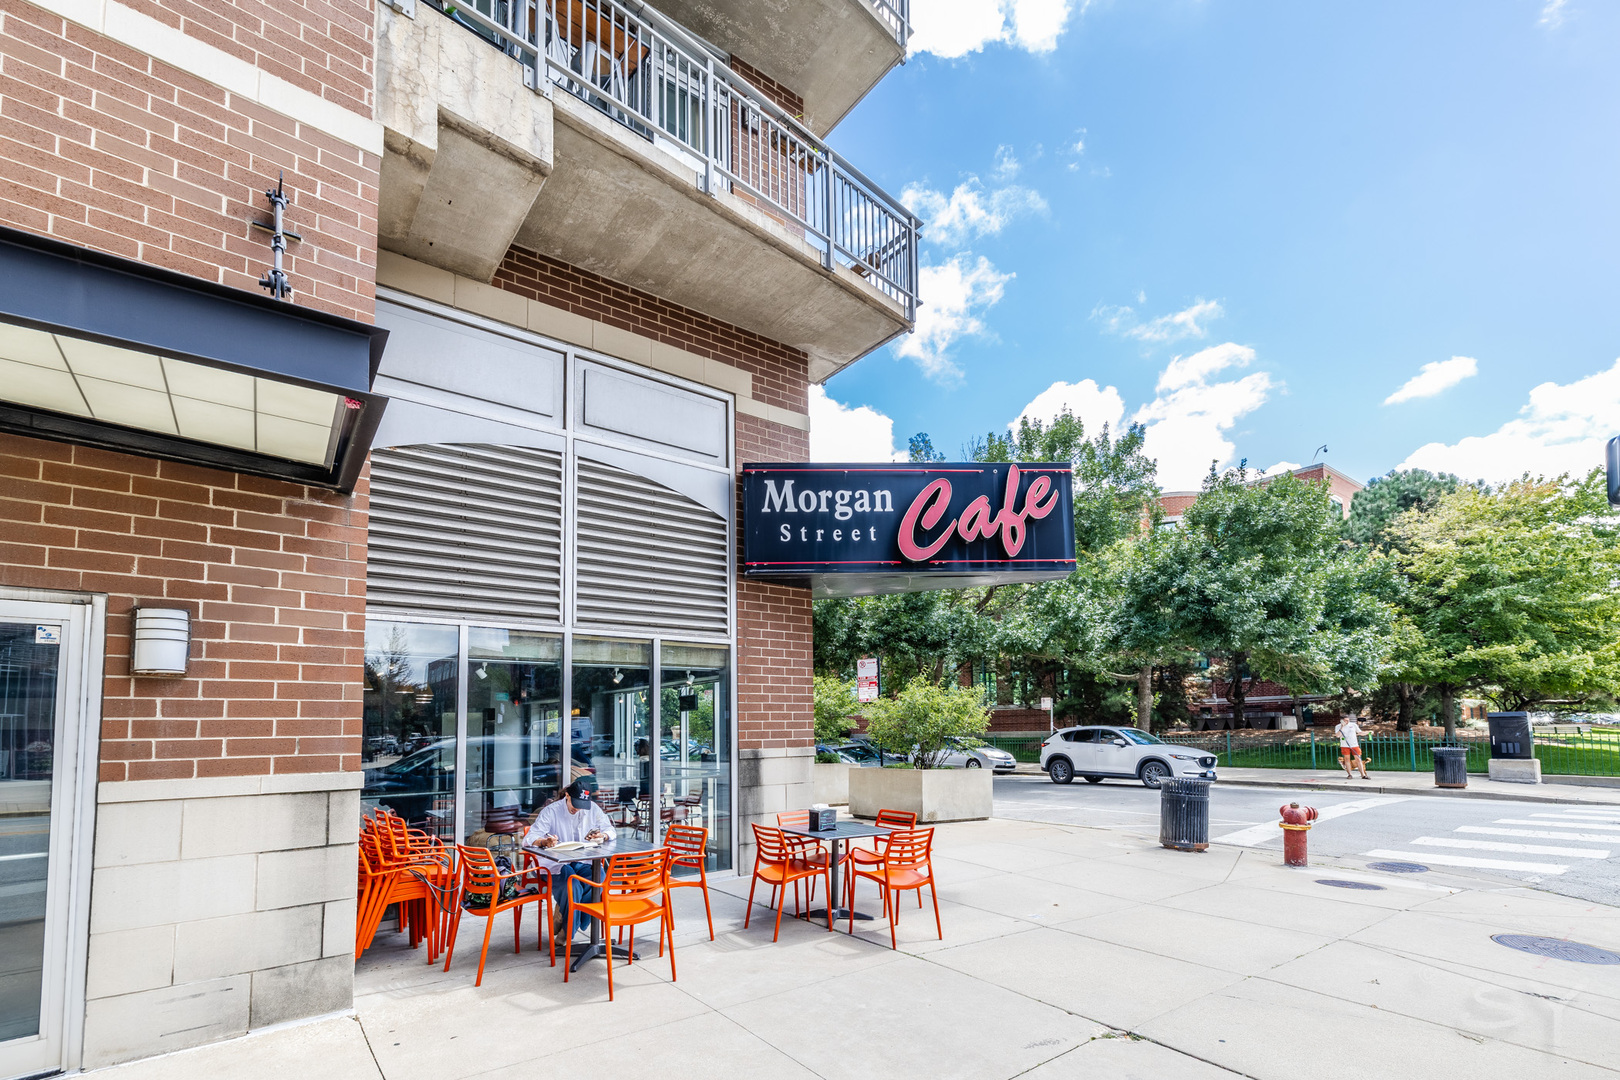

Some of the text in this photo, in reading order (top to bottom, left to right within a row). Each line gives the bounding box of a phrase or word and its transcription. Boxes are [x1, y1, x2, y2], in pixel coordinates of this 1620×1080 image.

[761, 480, 894, 520] Morgan
[897, 464, 1059, 562] Cafe
[780, 524, 877, 542] Street
